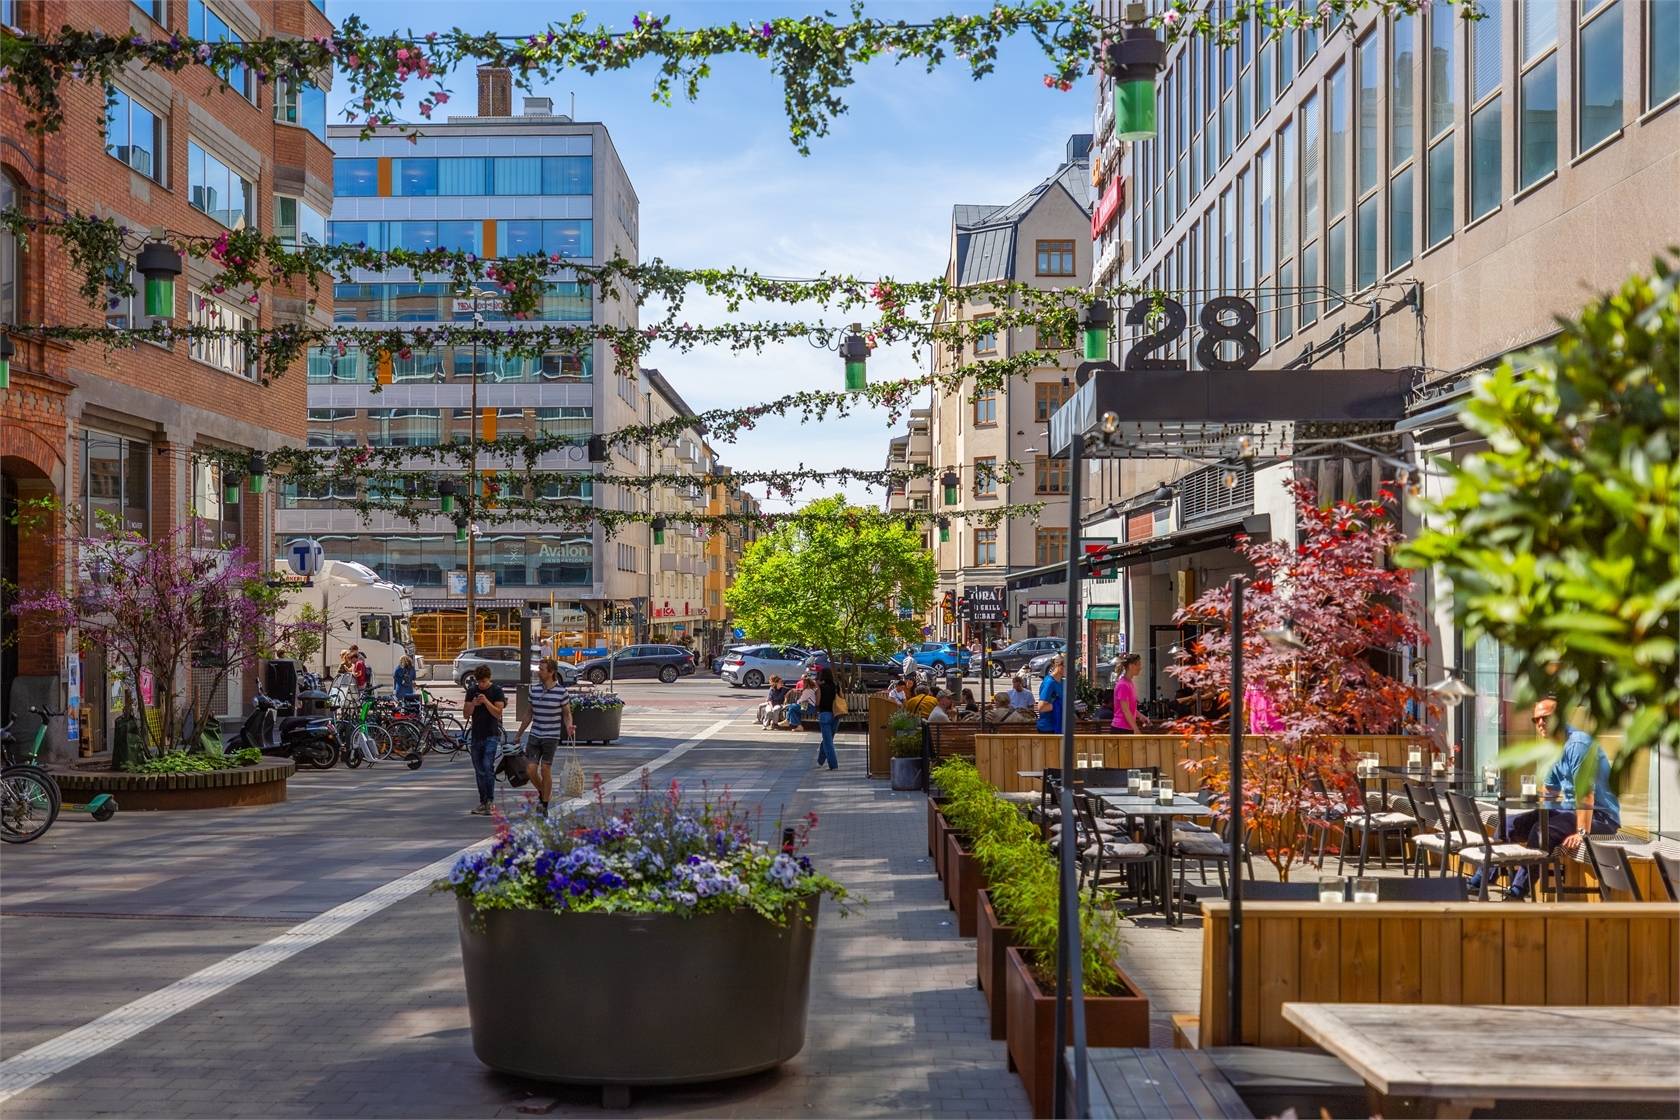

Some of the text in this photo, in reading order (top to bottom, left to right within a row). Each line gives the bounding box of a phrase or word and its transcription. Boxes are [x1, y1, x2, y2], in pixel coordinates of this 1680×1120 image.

[1125, 296, 1260, 371] 28
[293, 546, 310, 571] T
[539, 543, 588, 557] Avalon
[663, 607, 676, 616] ICA
